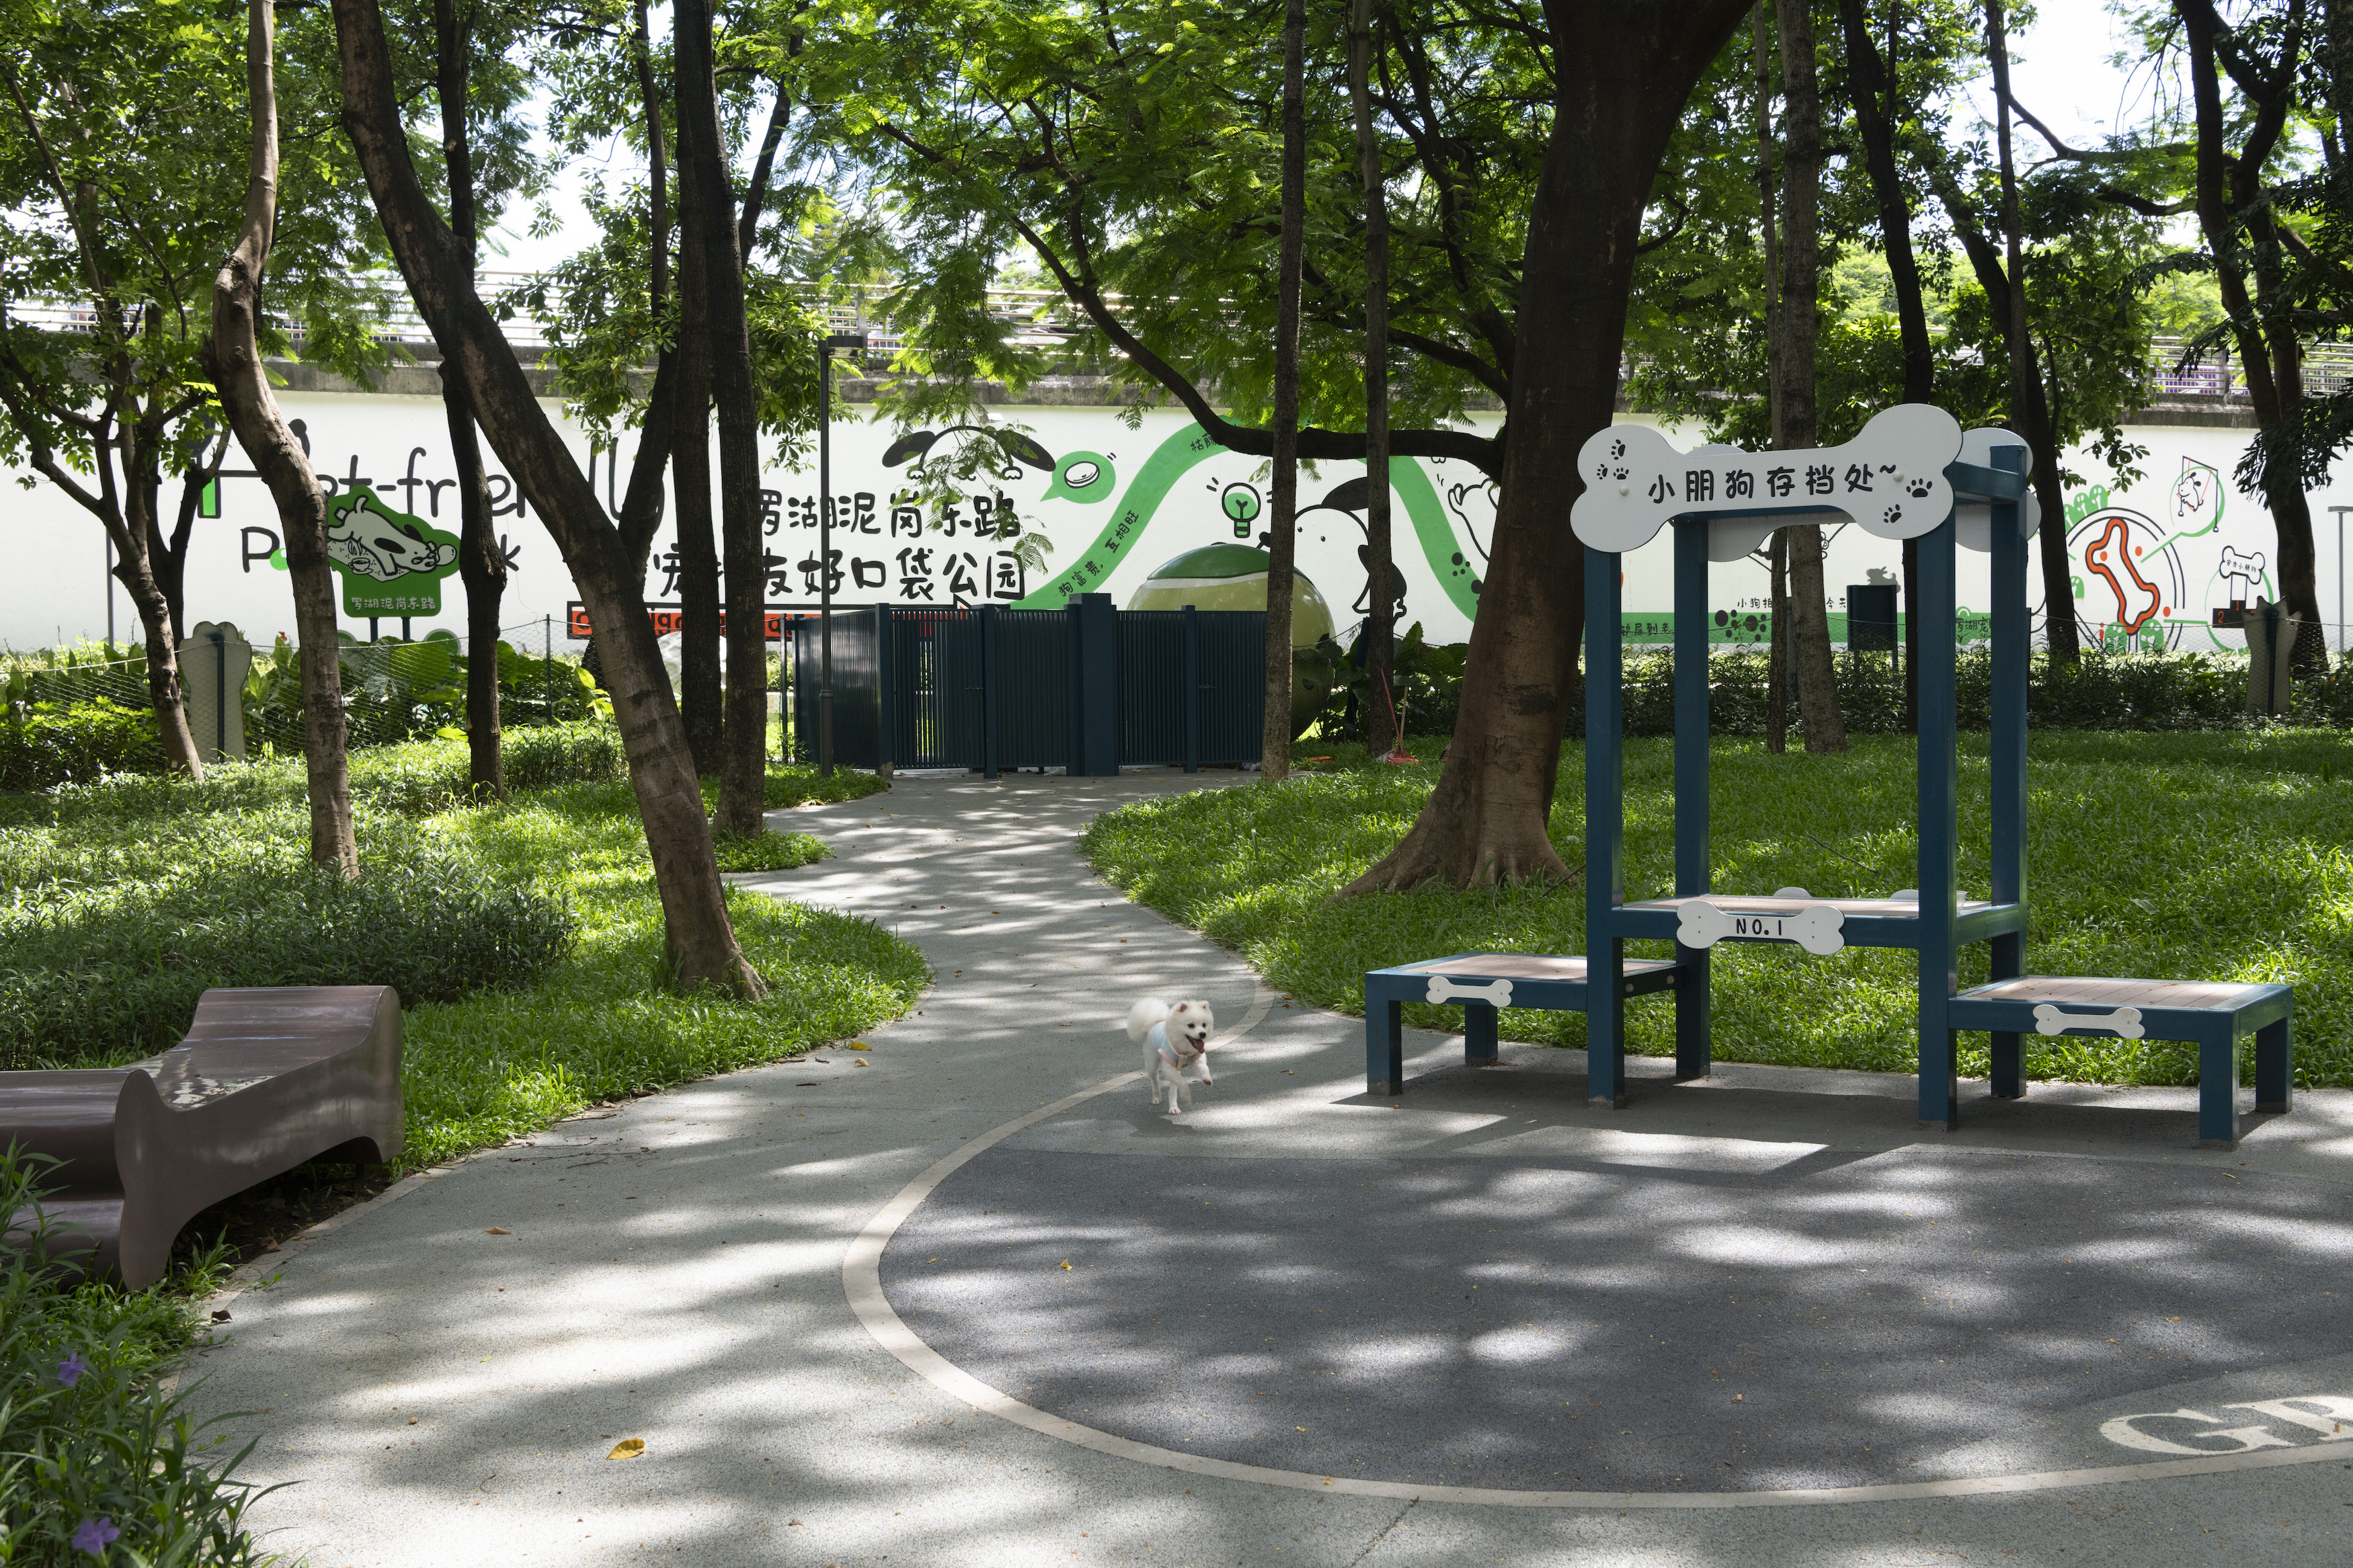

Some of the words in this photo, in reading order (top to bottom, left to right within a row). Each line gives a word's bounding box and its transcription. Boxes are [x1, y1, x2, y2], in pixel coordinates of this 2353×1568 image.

[351, 595, 436, 610] 罗湖泥岗东路
[2218, 610, 2225, 623] 2
[1955, 616, 1991, 633] 罗湖宠
